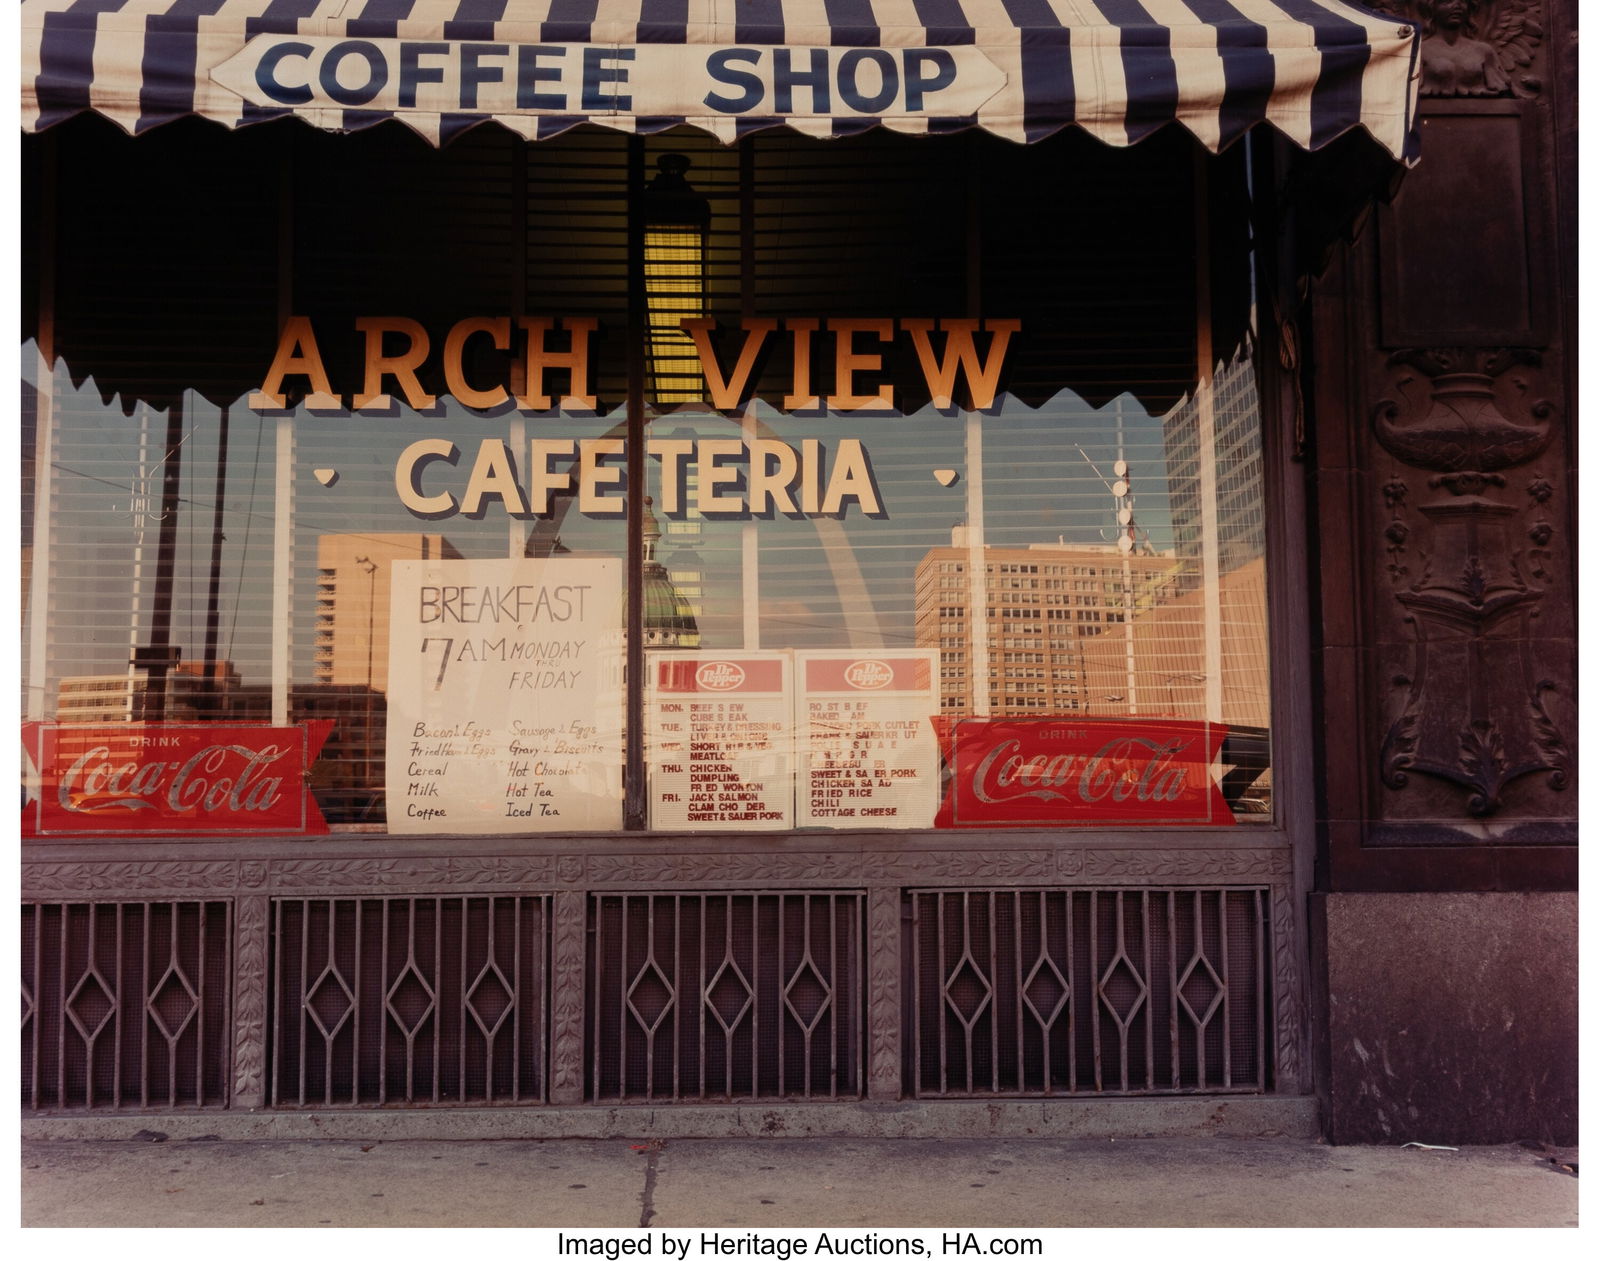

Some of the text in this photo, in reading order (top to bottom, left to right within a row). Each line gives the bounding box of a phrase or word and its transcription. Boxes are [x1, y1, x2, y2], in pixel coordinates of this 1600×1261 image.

[255, 42, 957, 115] COFFEE SHOP
[249, 316, 1022, 411] ARCH VIEW
[420, 585, 592, 624] BREAKFAST
[509, 640, 587, 660] MONDAY
[509, 670, 582, 690] FRIDAY
[661, 704, 684, 712] MON.
[690, 704, 713, 712] BEEF
[690, 713, 714, 721] CUBE
[809, 712, 840, 720] BAKED
[462, 721, 493, 742] Eggs
[508, 719, 556, 741] Sausage
[568, 719, 598, 740] Eggs
[885, 721, 920, 730] CUTLET
[1039, 729, 1088, 740] DRINK
[129, 736, 181, 748] DRINK
[508, 739, 540, 757] Gravy
[690, 742, 721, 751] SHORT
[407, 761, 448, 777] Cereal
[508, 760, 529, 778] Hot
[662, 764, 733, 773] THU. CHICKEN
[811, 770, 842, 779] SWEET
[845, 770, 852, 778] &
[890, 769, 917, 778] PORK
[972, 737, 1196, 803] Coca-Cola
[58, 744, 293, 813] Coca-Cola
[690, 774, 740, 783] DUMPLING
[811, 779, 855, 788] CHICKEN
[407, 782, 440, 798] Milk
[505, 781, 555, 798] Hot Tea
[811, 788, 873, 798] FRIED RICE
[662, 793, 759, 802] FRI. JACK SALMON
[811, 798, 840, 807] CHILI
[406, 803, 448, 821] Coffee
[505, 801, 561, 818] Iced Tea
[688, 803, 714, 811] CLAM
[811, 807, 897, 817] COTTAGE CHEESE
[687, 812, 718, 821] SWEET
[728, 812, 757, 821] SAUER
[759, 811, 784, 820] PORK
